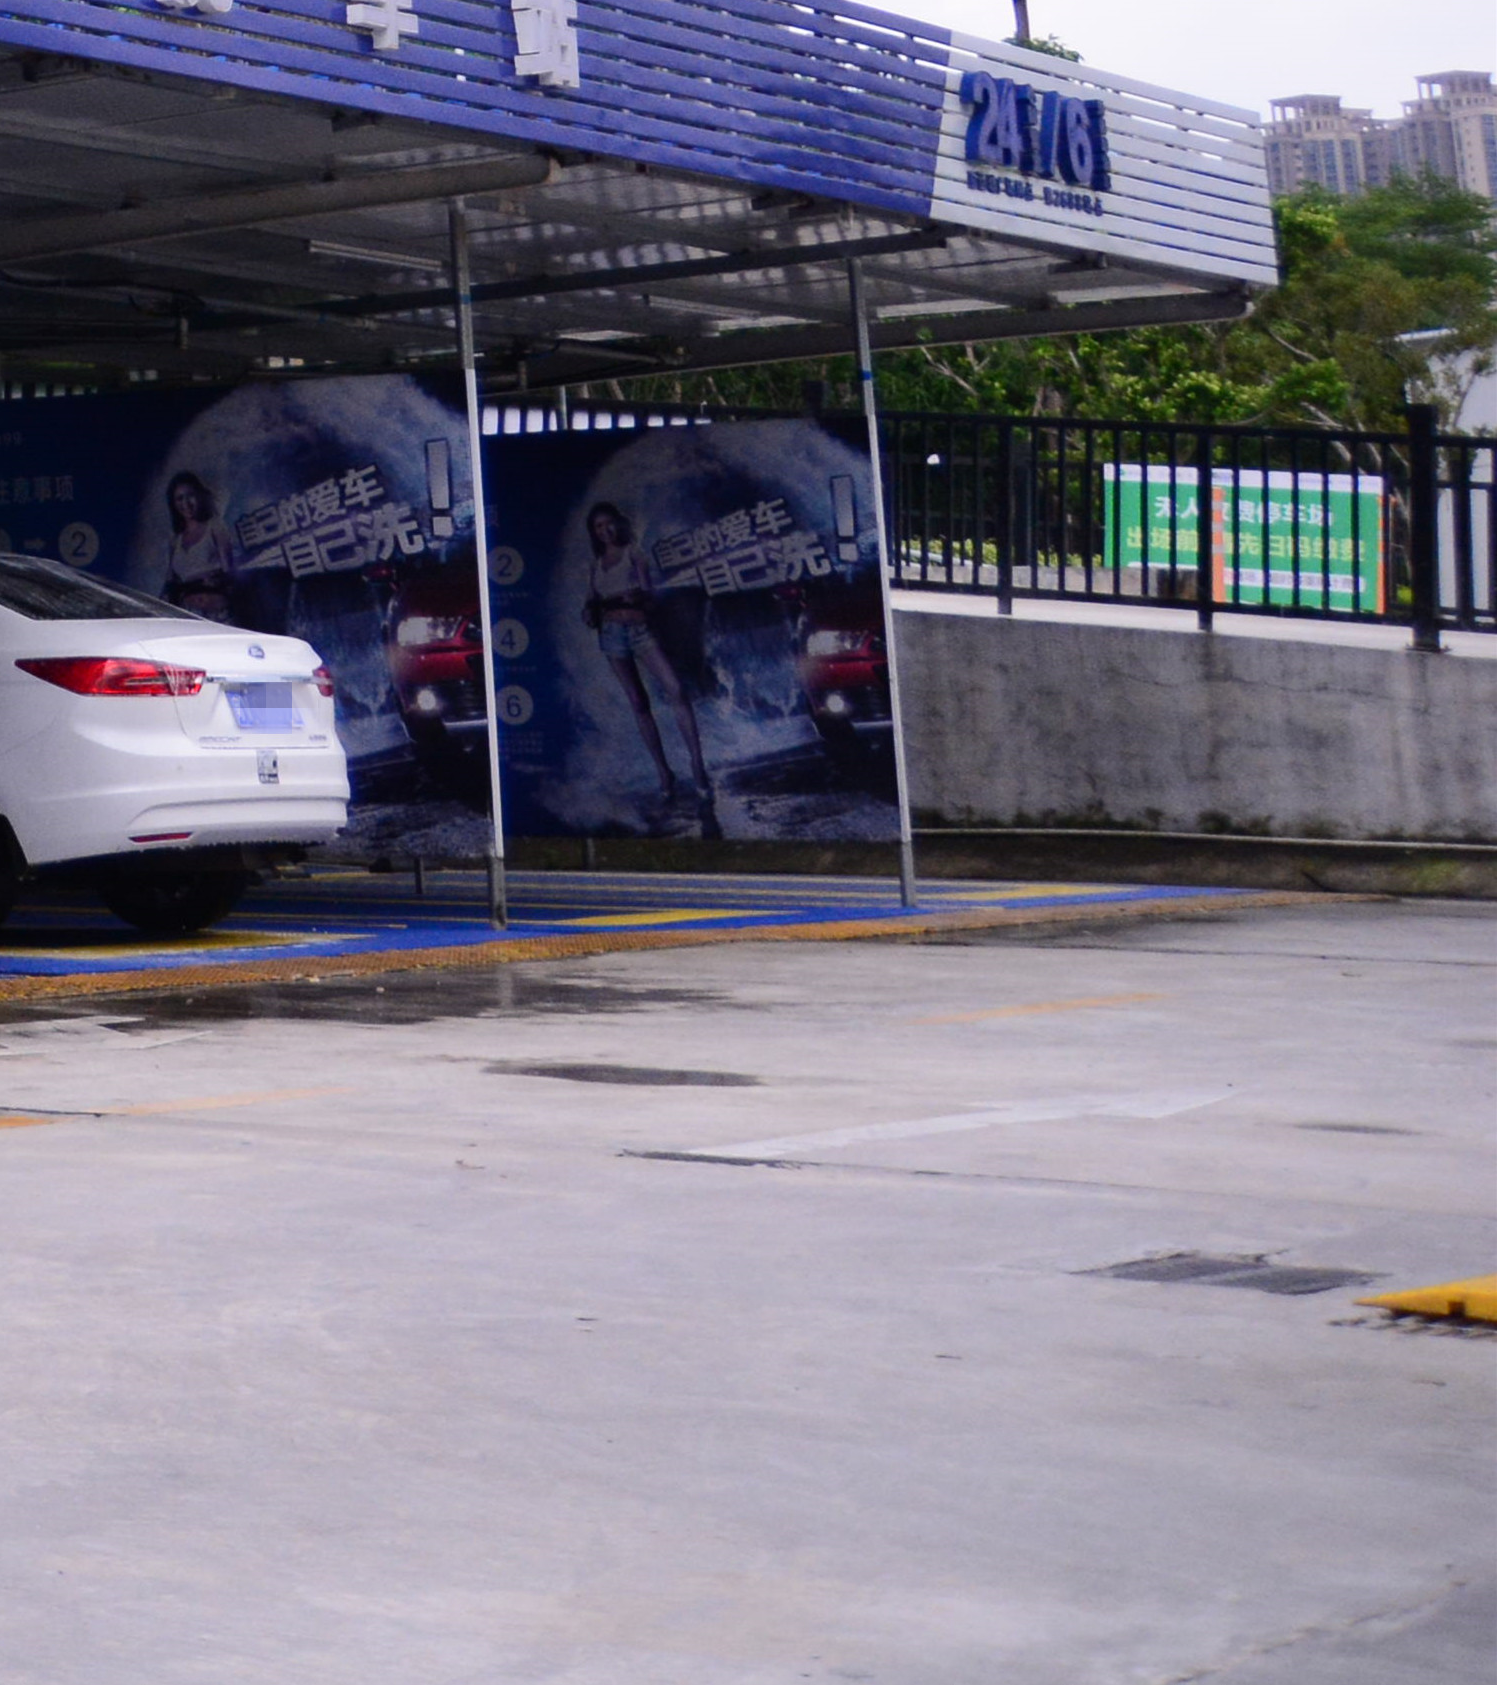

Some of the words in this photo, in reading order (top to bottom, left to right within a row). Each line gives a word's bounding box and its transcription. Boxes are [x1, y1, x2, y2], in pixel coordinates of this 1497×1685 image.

[238, 465, 384, 549] 自己的爱车
[653, 499, 792, 570] 自己的爱车
